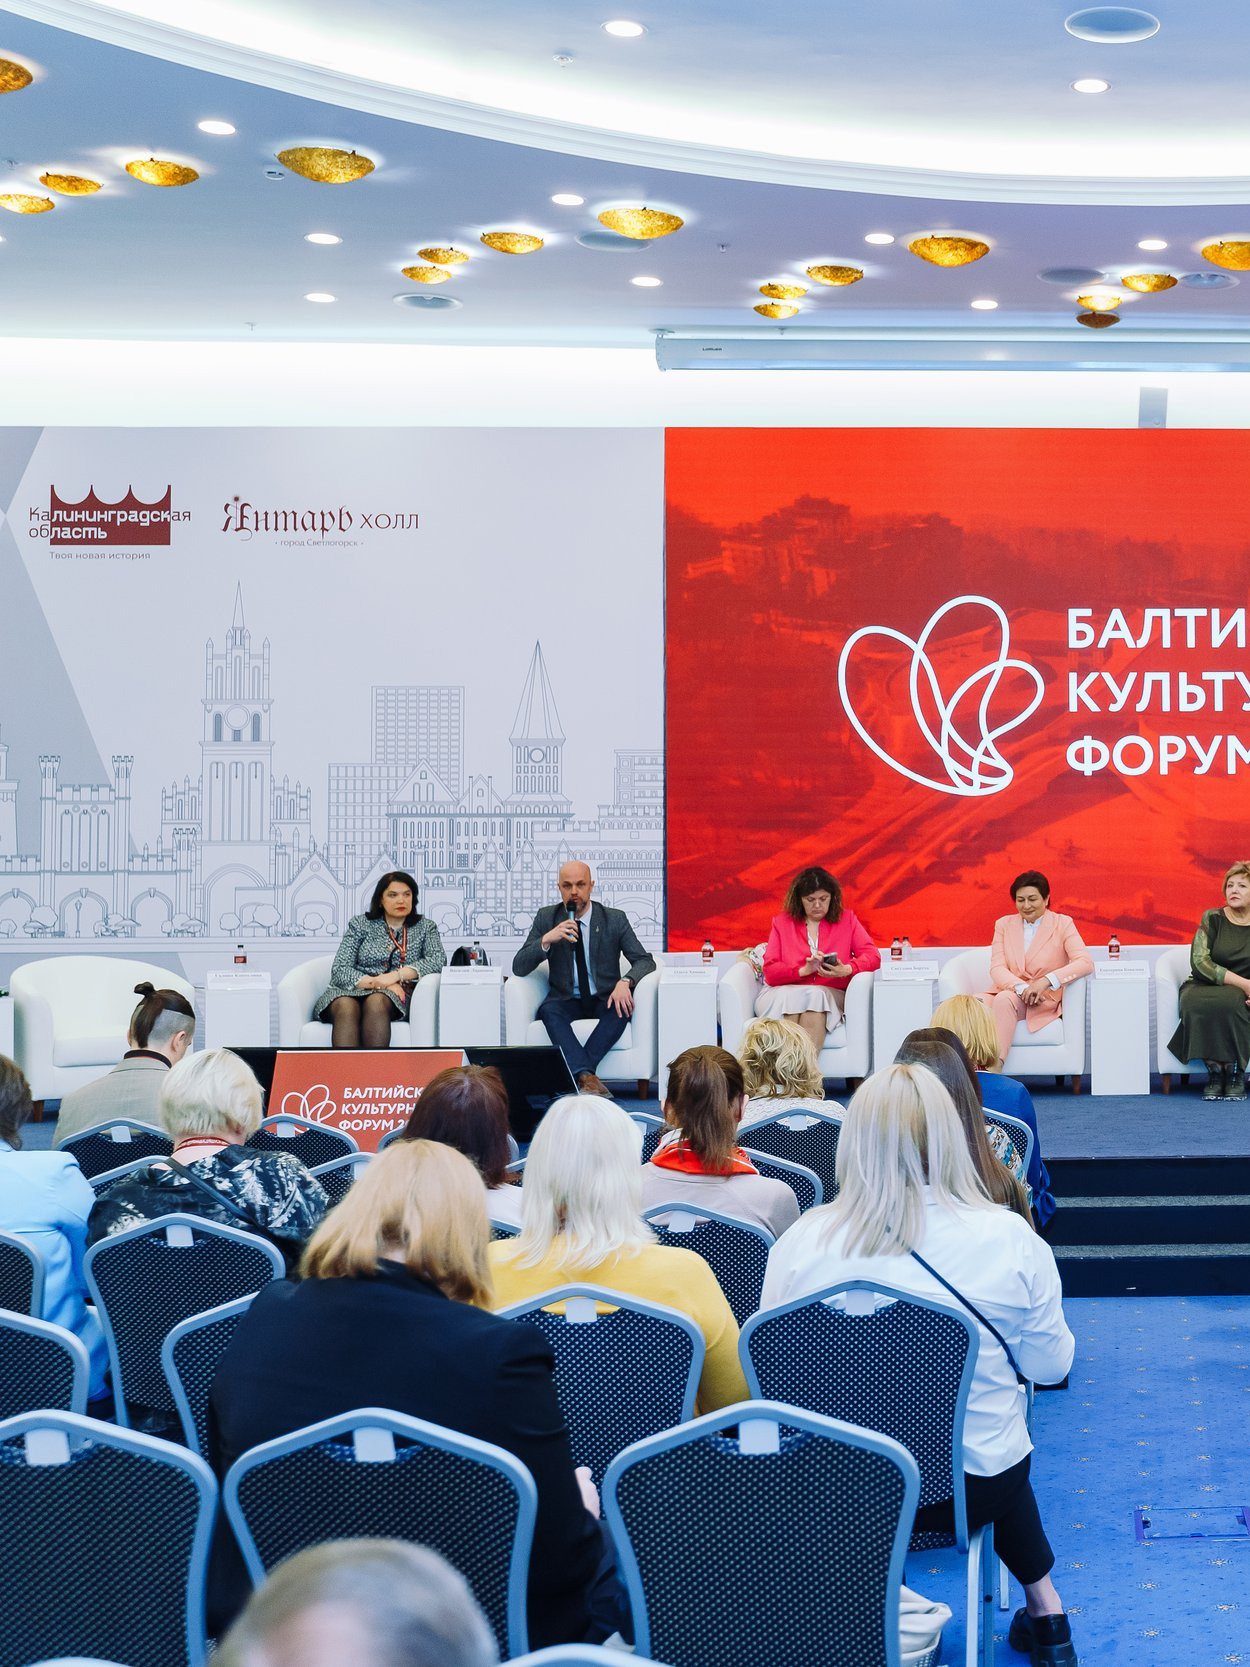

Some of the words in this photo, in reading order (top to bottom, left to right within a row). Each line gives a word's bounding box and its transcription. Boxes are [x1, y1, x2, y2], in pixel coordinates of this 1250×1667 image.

[29, 507, 192, 527] Калининградская
[359, 513, 420, 529] холл
[29, 524, 108, 539] область
[50, 552, 73, 560] Твоя
[109, 553, 151, 561] история
[343, 1085, 424, 1099] БАЛТИЙСК
[341, 1103, 416, 1115] КУЛЬТУРН
[338, 1119, 394, 1131] ФОРУМ
